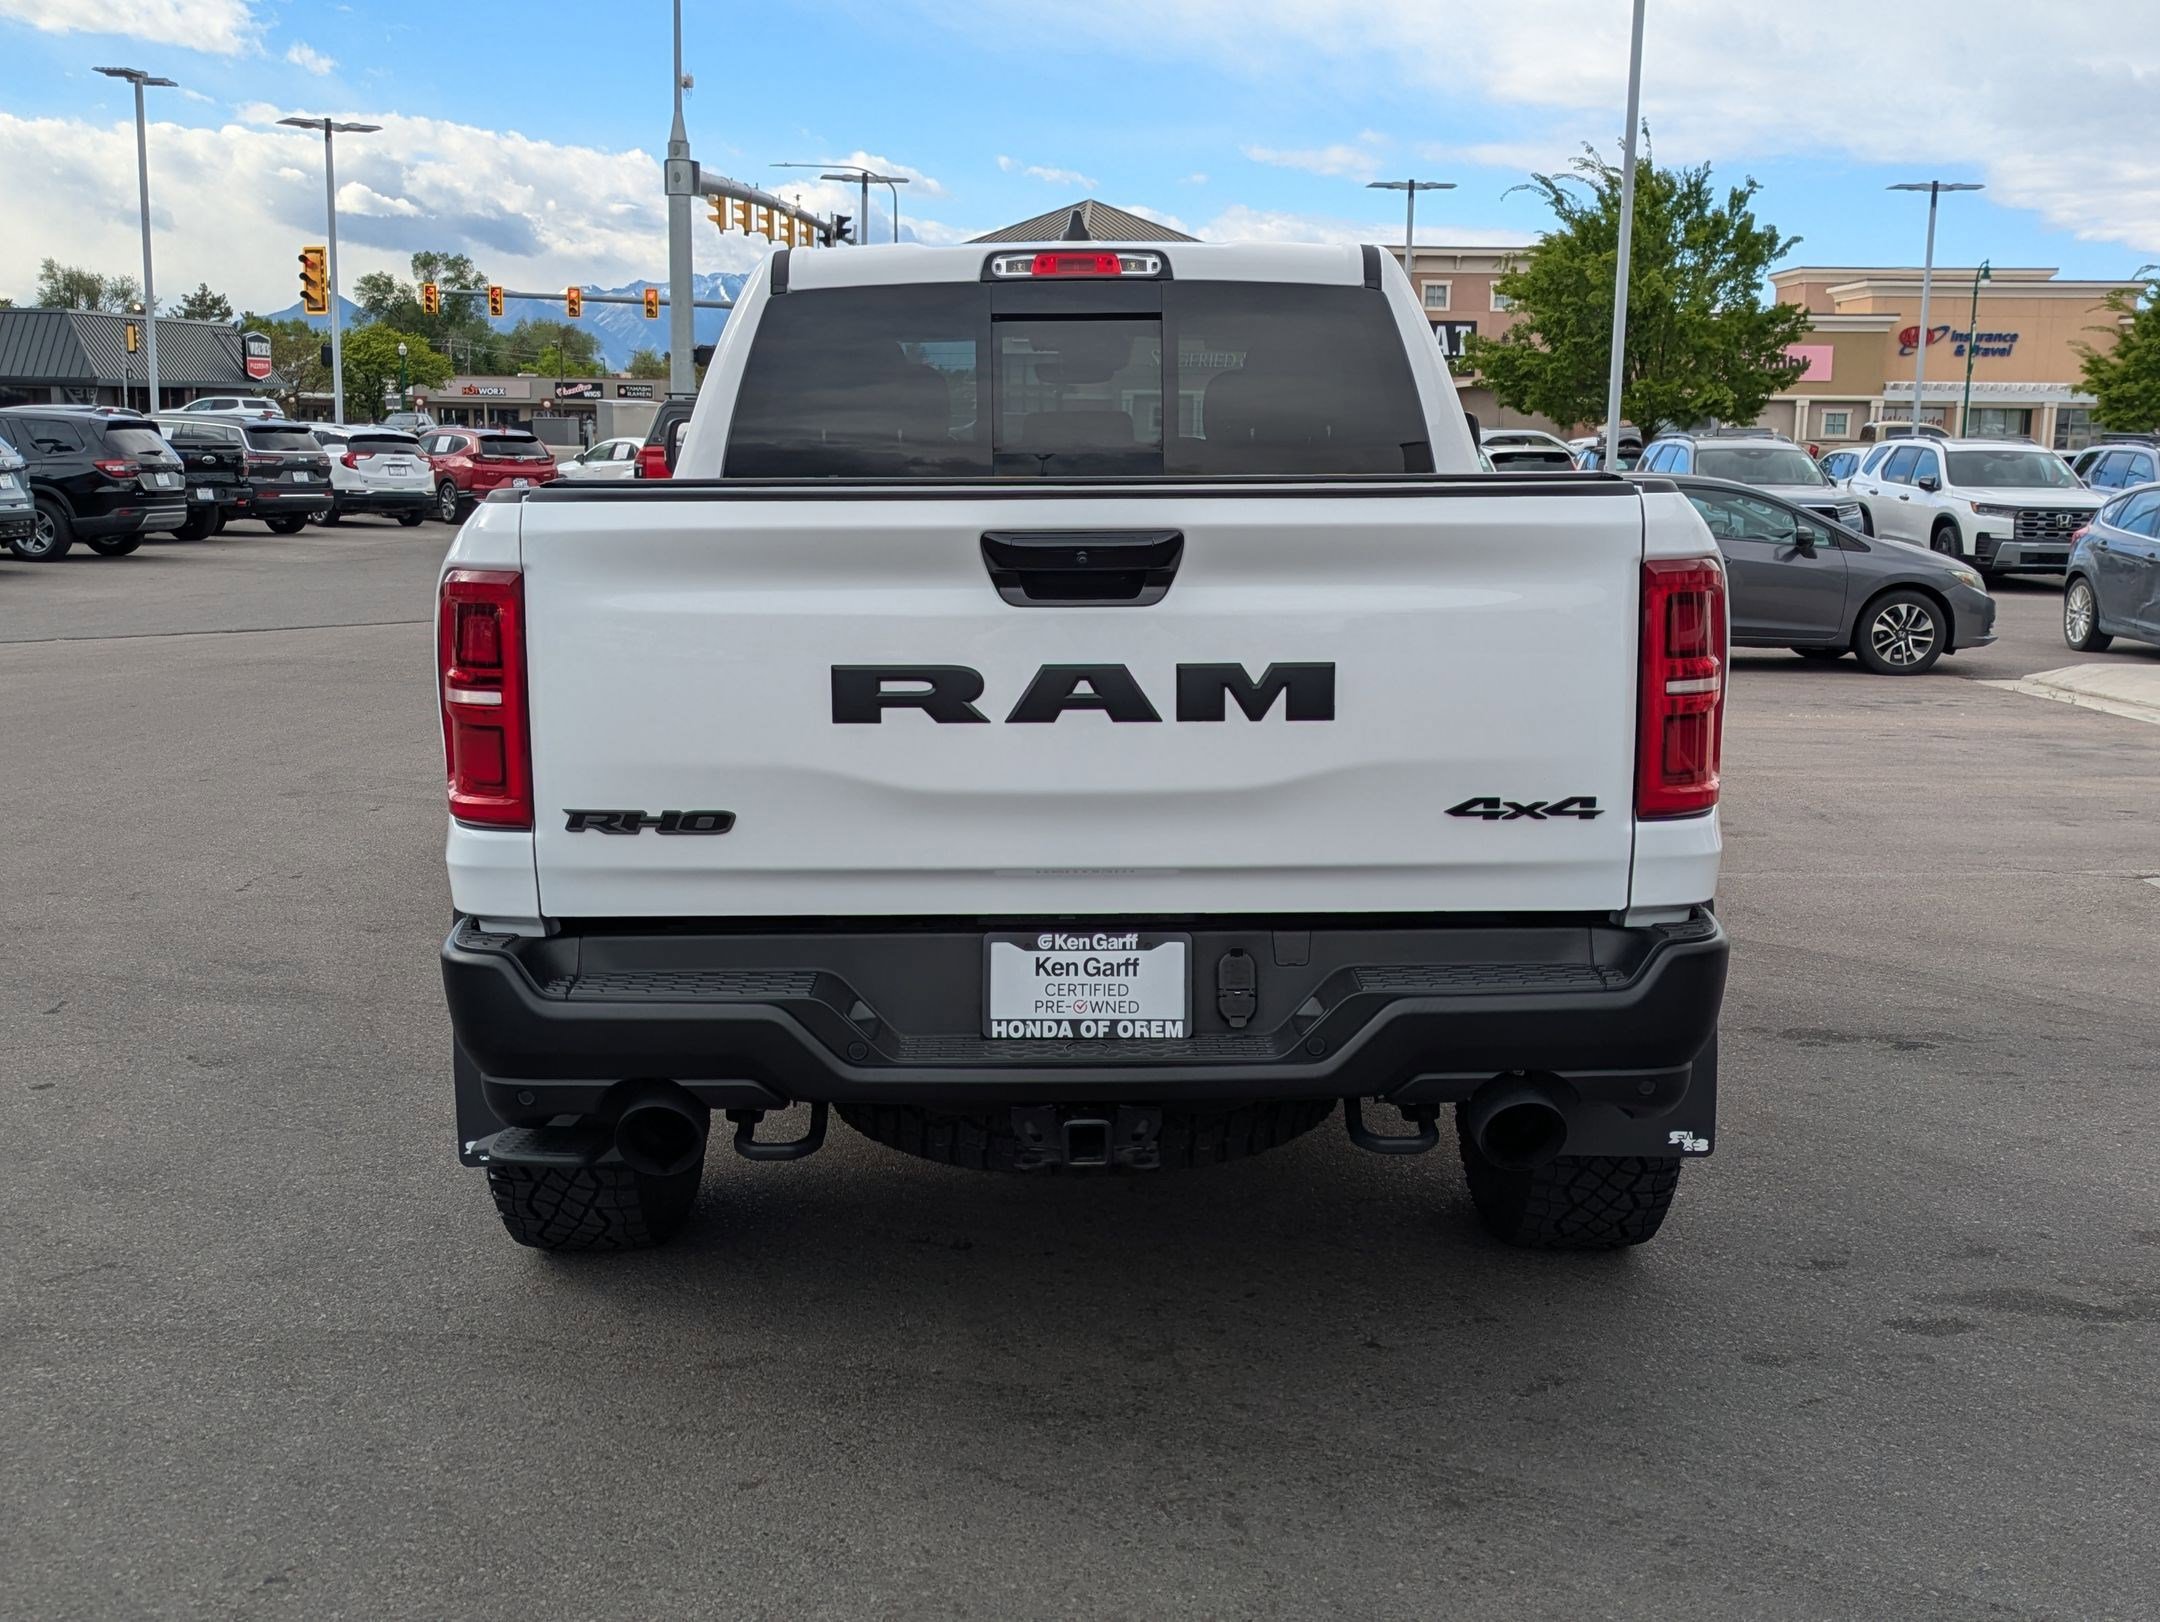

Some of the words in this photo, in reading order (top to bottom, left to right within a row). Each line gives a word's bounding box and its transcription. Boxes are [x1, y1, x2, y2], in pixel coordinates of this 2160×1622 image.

[1950, 330, 2019, 343] Insrance
[831, 662, 1335, 724] RAM
[1444, 796, 1605, 820] 4x4
[562, 808, 737, 835] RHO
[1054, 933, 1090, 950] Ken
[1092, 933, 1139, 950] Garff
[1035, 956, 1079, 977] Ken
[1083, 956, 1140, 977] Garff
[1045, 983, 1129, 997] CERTIFIED
[991, 1020, 1074, 1038] HONDA
[1080, 1020, 1111, 1038] OF
[1117, 1020, 1184, 1038] OREM
